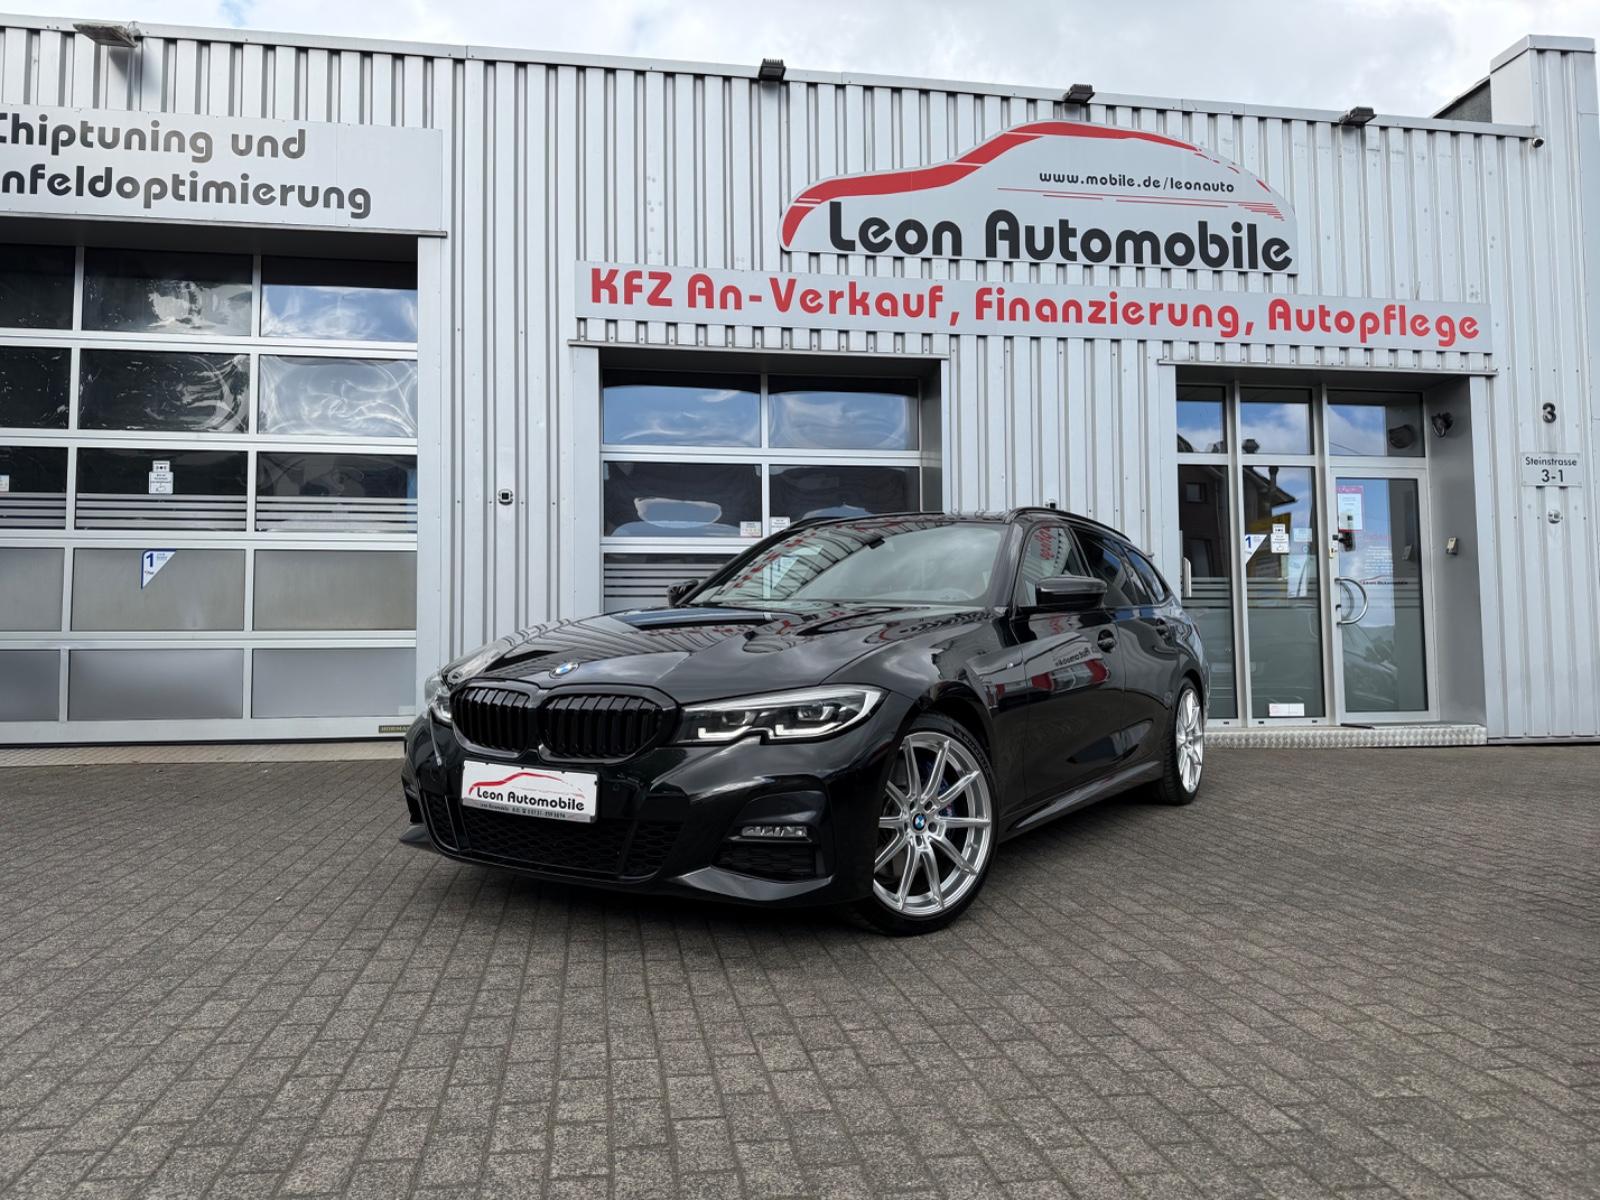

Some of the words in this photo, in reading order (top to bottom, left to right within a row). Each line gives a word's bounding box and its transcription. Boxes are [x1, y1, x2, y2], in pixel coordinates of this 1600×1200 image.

[231, 128, 306, 160] und
[2, 164, 372, 219] nfeldoptimierung
[1039, 170, 1235, 194] www.mobile.de/leonauto
[829, 201, 963, 257] Leon
[985, 209, 1293, 271] Automobile
[687, 273, 960, 326] An-Verkauf,
[975, 287, 1254, 338] Finanzierung,
[1268, 298, 1479, 347] Autopflege
[1542, 402, 1557, 424] 3
[1525, 456, 1577, 466] Steinstrasse
[1541, 468, 1564, 483] 3-1
[145, 552, 154, 567] 1
[476, 786, 504, 802] Leon
[507, 790, 586, 812] Automobile
